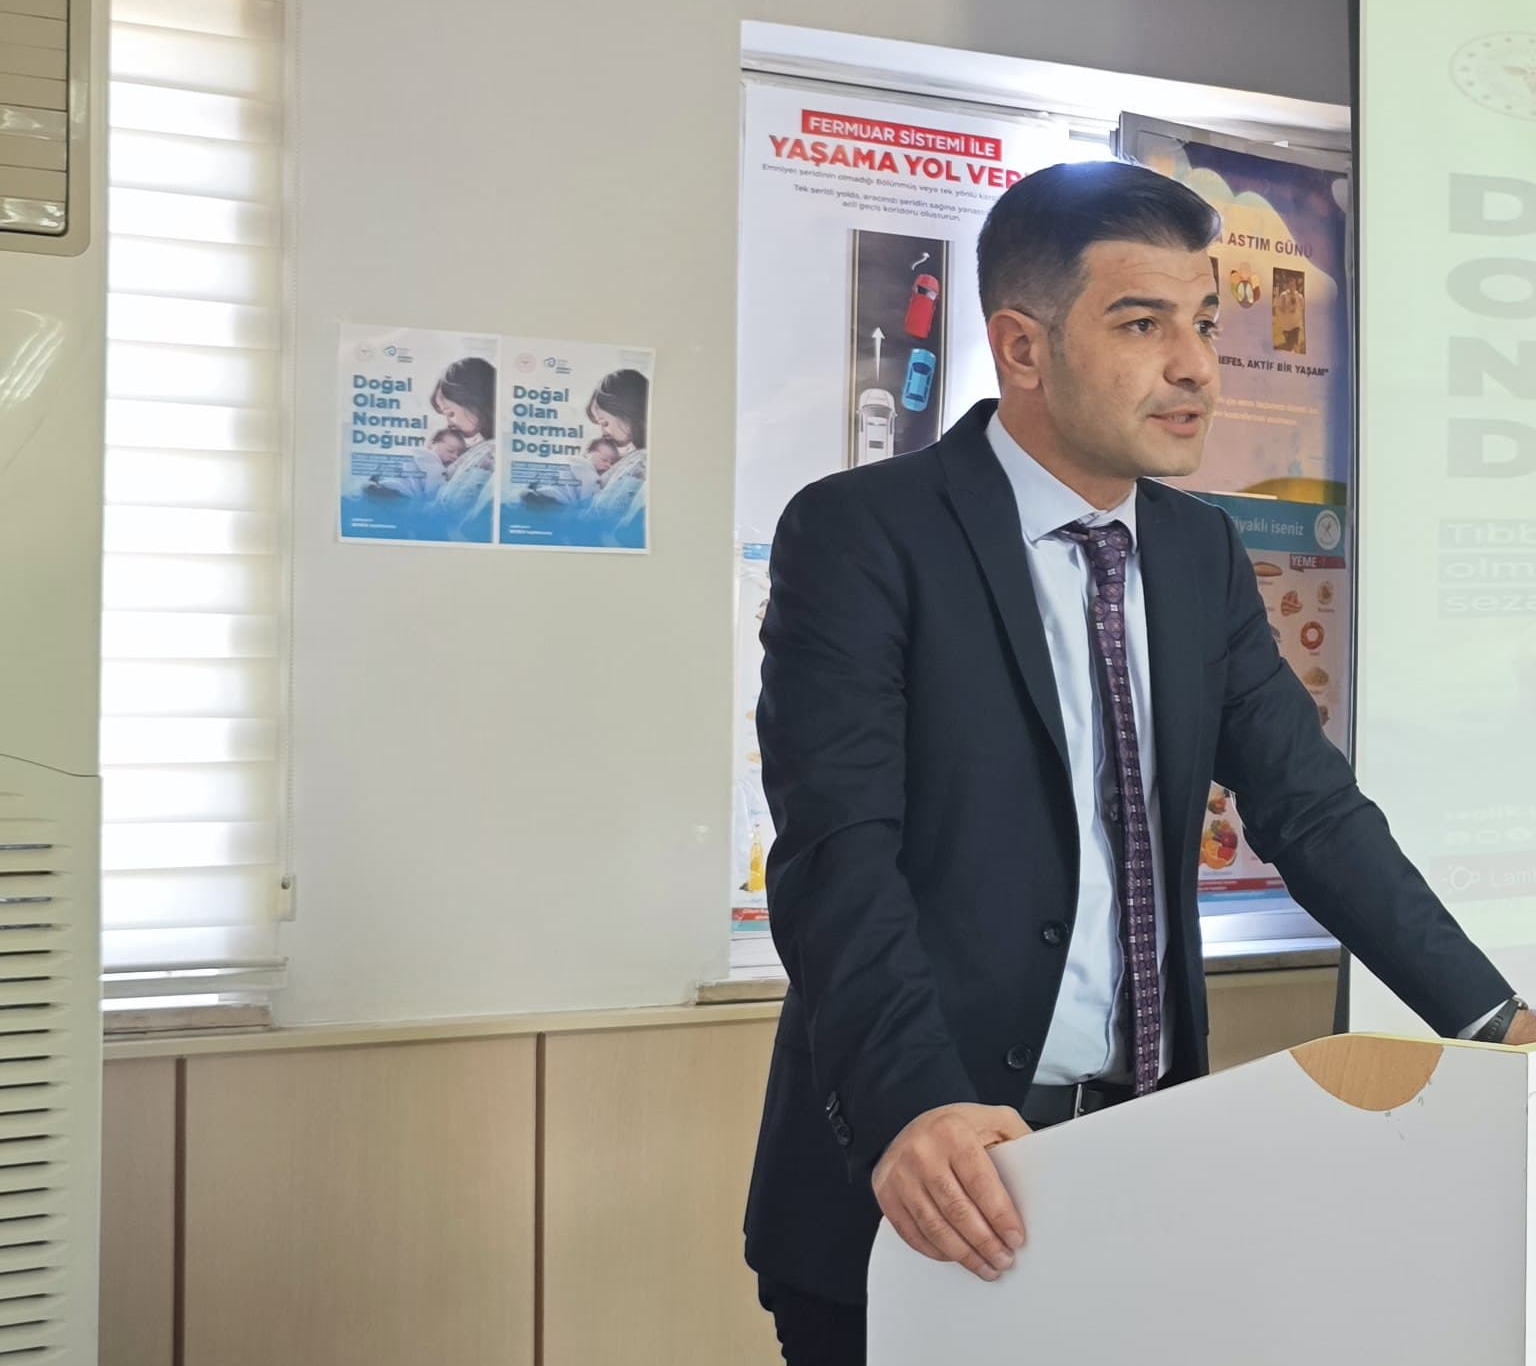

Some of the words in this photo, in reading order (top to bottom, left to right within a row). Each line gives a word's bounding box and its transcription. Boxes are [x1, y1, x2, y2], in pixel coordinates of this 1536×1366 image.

[809, 116, 895, 142] FERMUAR
[900, 129, 965, 153] SİSTEMİ
[969, 137, 996, 157] İLE
[768, 134, 899, 173] YAŞAMA
[903, 154, 961, 182] YOL
[1228, 232, 1270, 251] ASTIM
[1275, 239, 1313, 258] GÜNÜ
[1247, 360, 1274, 371] AKTİF
[1277, 362, 1292, 373] BİR
[353, 374, 412, 393] Doğal
[353, 393, 400, 409] Olan
[513, 386, 569, 404] Doğal
[513, 404, 558, 419] Olan
[353, 412, 428, 430] Normal
[512, 421, 583, 439] Normal
[353, 430, 425, 449] Doğum
[512, 439, 581, 457] Doğum
[1271, 519, 1304, 535] iseniz
